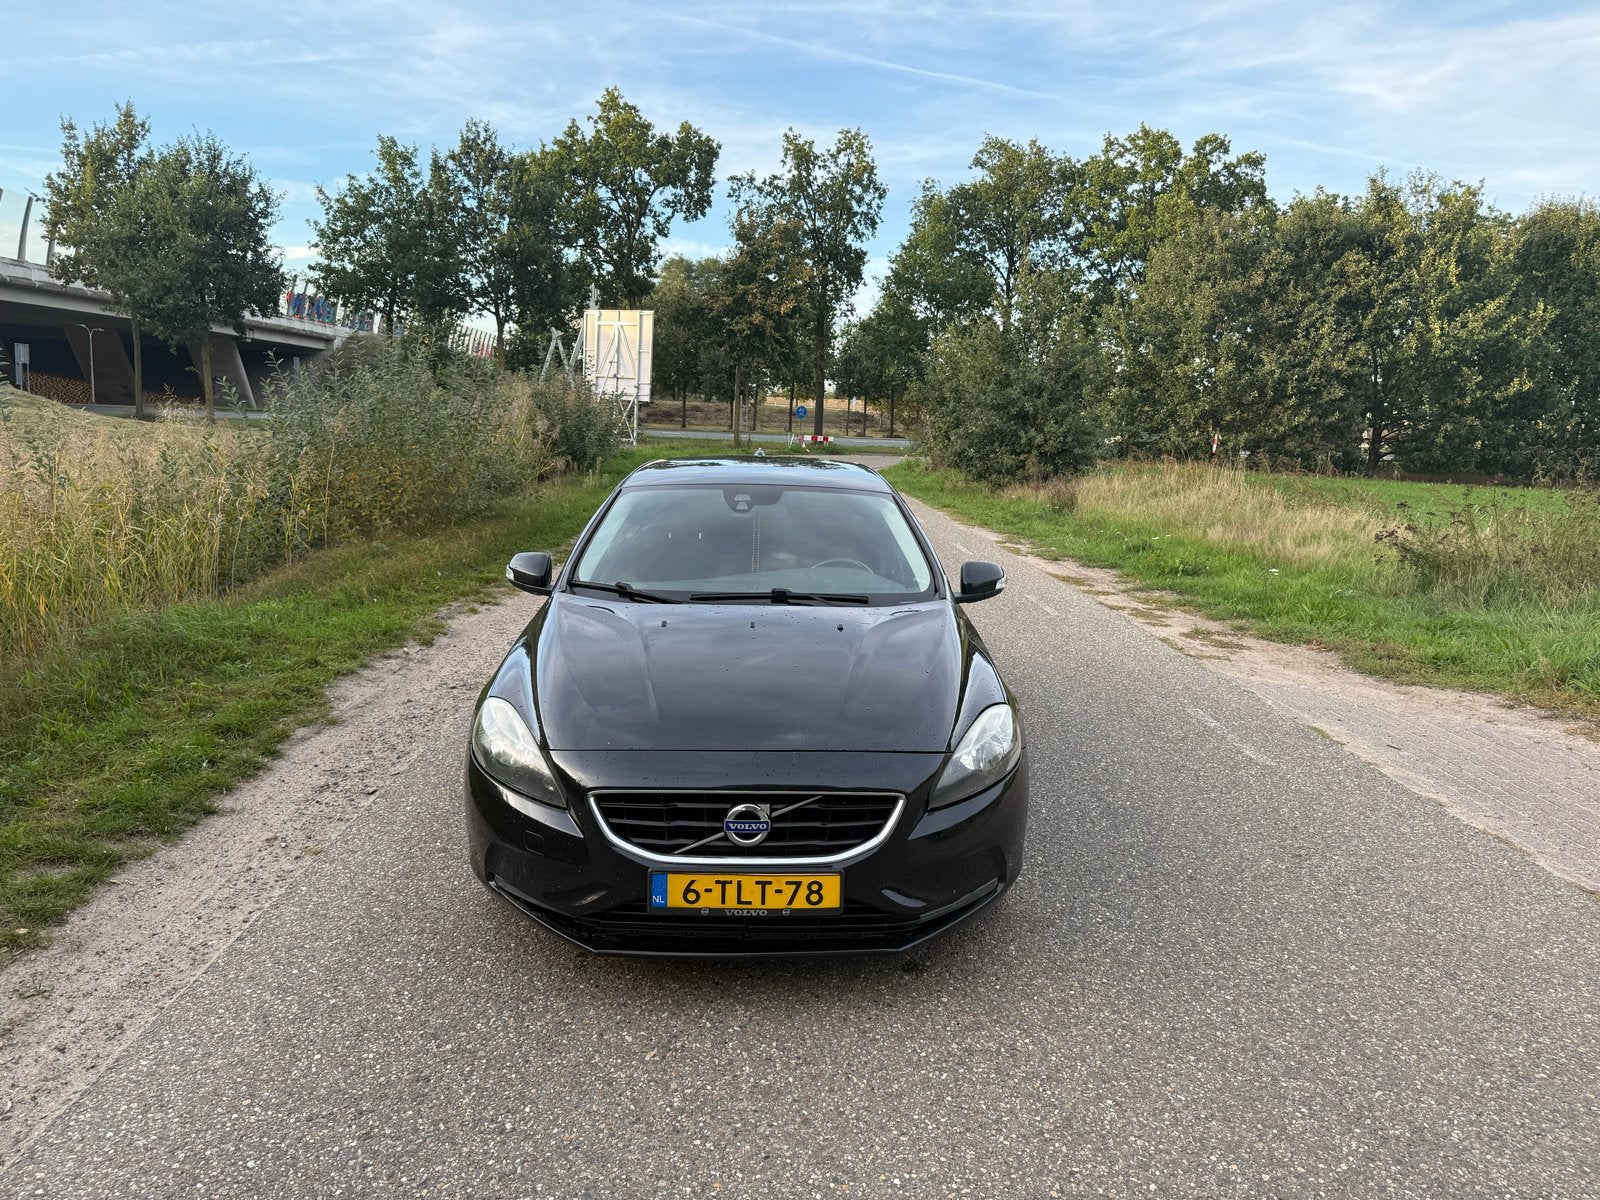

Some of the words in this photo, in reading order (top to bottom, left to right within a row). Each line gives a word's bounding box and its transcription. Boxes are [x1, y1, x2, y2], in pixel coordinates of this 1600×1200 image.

[682, 879, 824, 906] 6-TLT-78
[652, 895, 665, 904] NL
[724, 909, 768, 917] VOLVO
